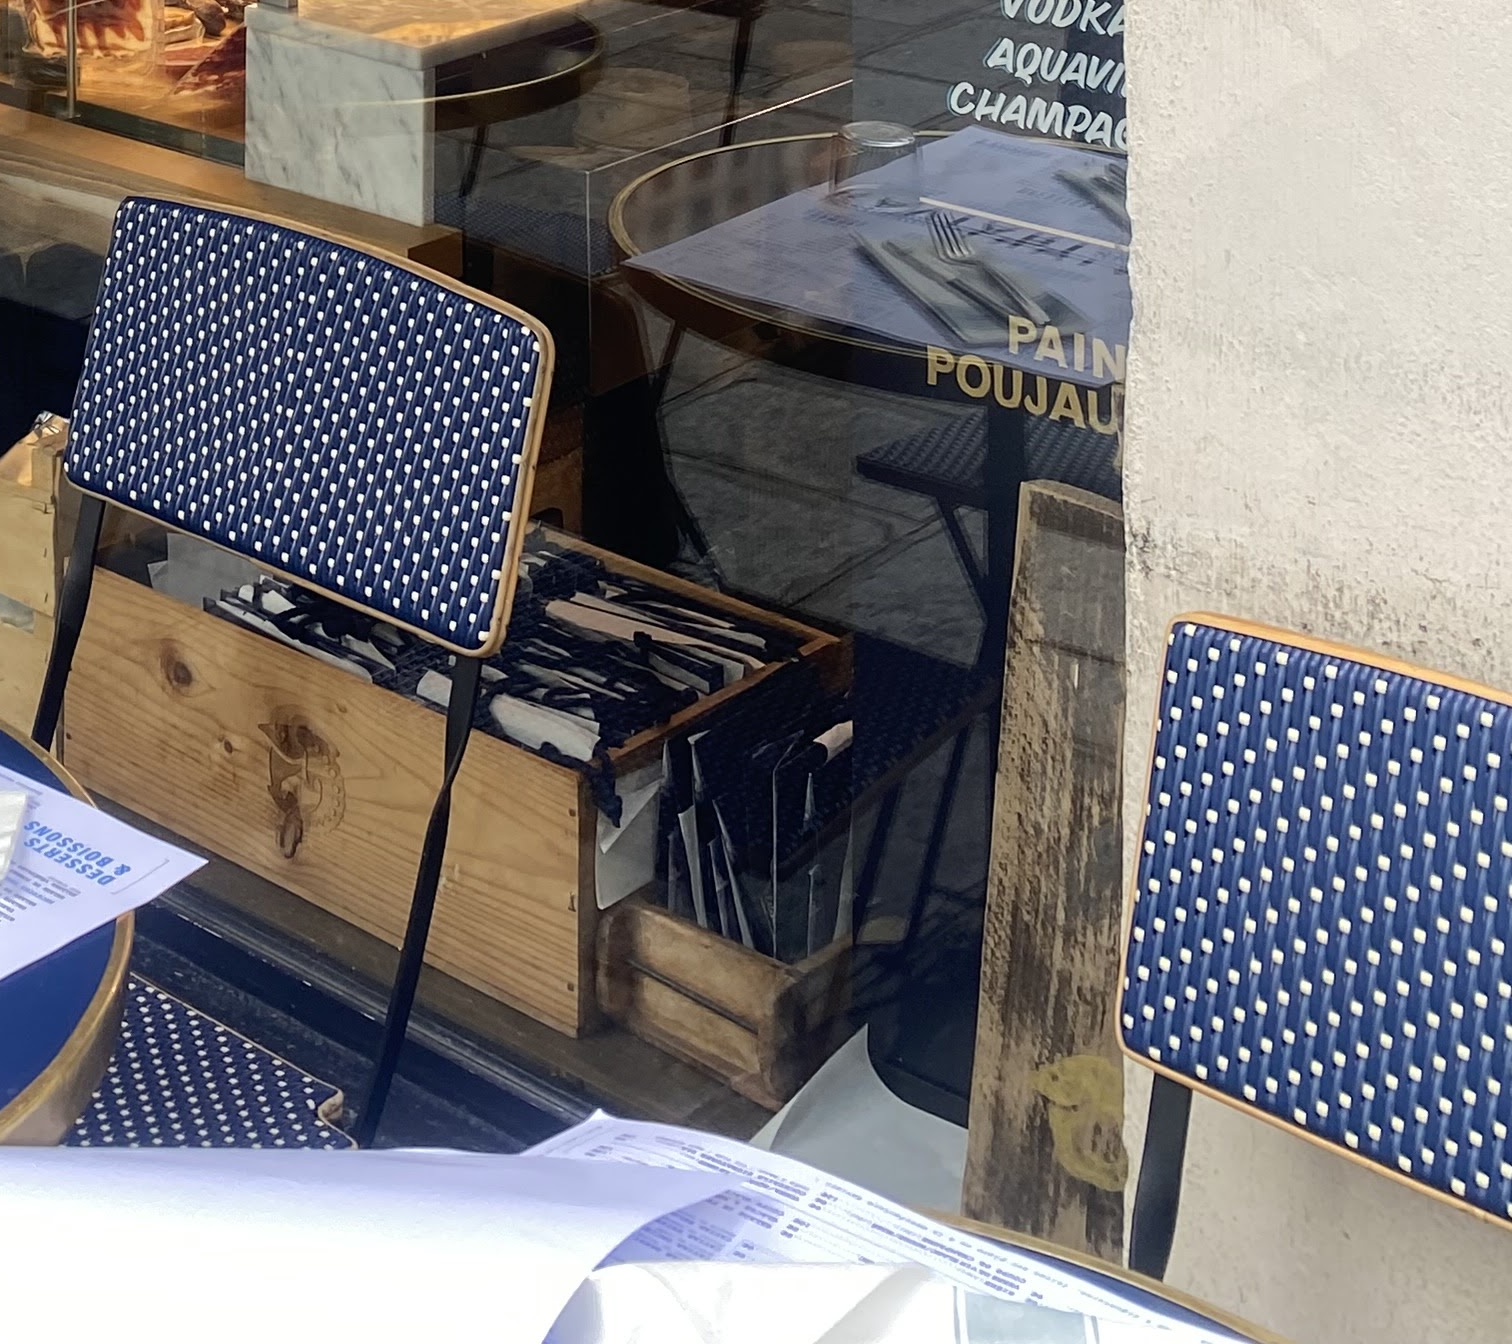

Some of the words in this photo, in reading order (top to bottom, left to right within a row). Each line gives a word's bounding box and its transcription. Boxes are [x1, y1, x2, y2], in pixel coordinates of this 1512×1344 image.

[983, 37, 1126, 98] AQUAVI
[1008, 315, 1127, 382] PAIN
[926, 344, 1125, 435] POUJAU
[23, 820, 115, 867] BOISSONS
[23, 837, 117, 887] DESSERTS
